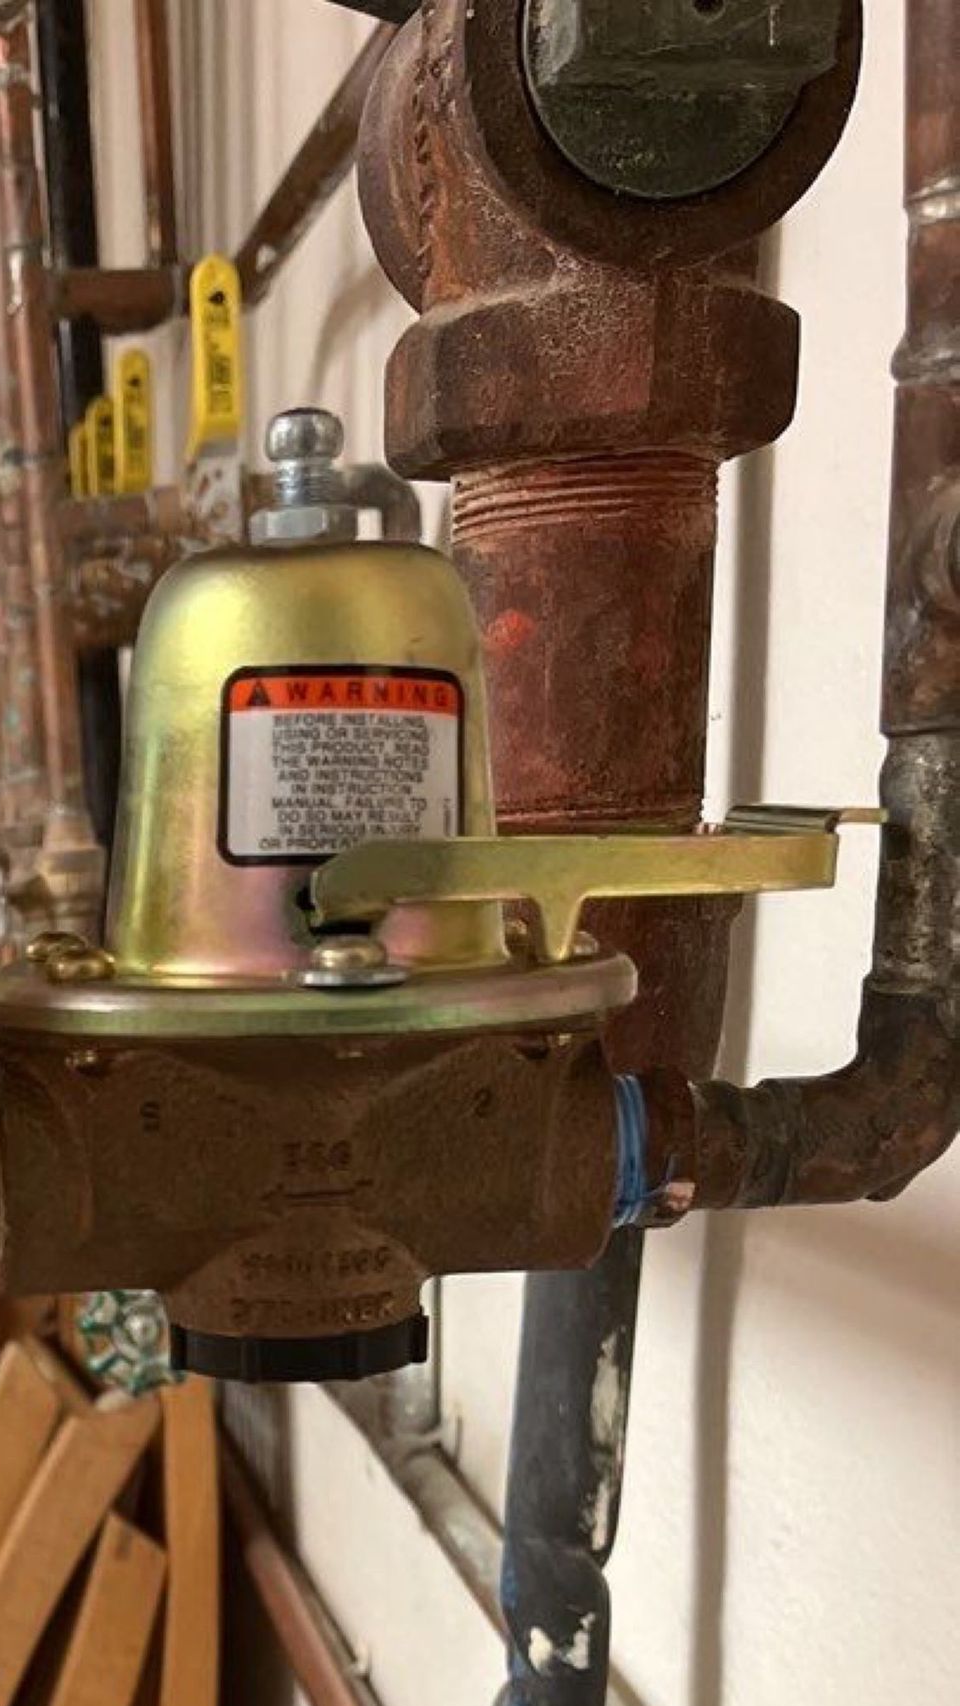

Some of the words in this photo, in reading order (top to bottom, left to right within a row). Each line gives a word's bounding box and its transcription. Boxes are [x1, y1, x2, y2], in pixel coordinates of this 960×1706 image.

[286, 680, 448, 707] WARNING
[273, 714, 336, 726] BEFORE
[273, 727, 321, 740] USING
[326, 727, 347, 740] OR
[353, 727, 428, 742] SERVICING
[272, 741, 306, 754] THIS
[394, 742, 429, 756] READ
[272, 755, 302, 768] THE
[306, 755, 379, 767] WARNING
[278, 769, 309, 781] AND
[315, 769, 423, 783] INSTRUCTIONS
[291, 783, 307, 794] IN
[311, 783, 413, 795] INSTRUCTION
[410, 798, 428, 812] TO
[277, 810, 300, 823] DO
[305, 810, 326, 823] SO
[331, 810, 362, 821] MAY
[279, 824, 293, 835] IN
[298, 824, 366, 837] SERIOUS
[259, 838, 281, 849] OR
